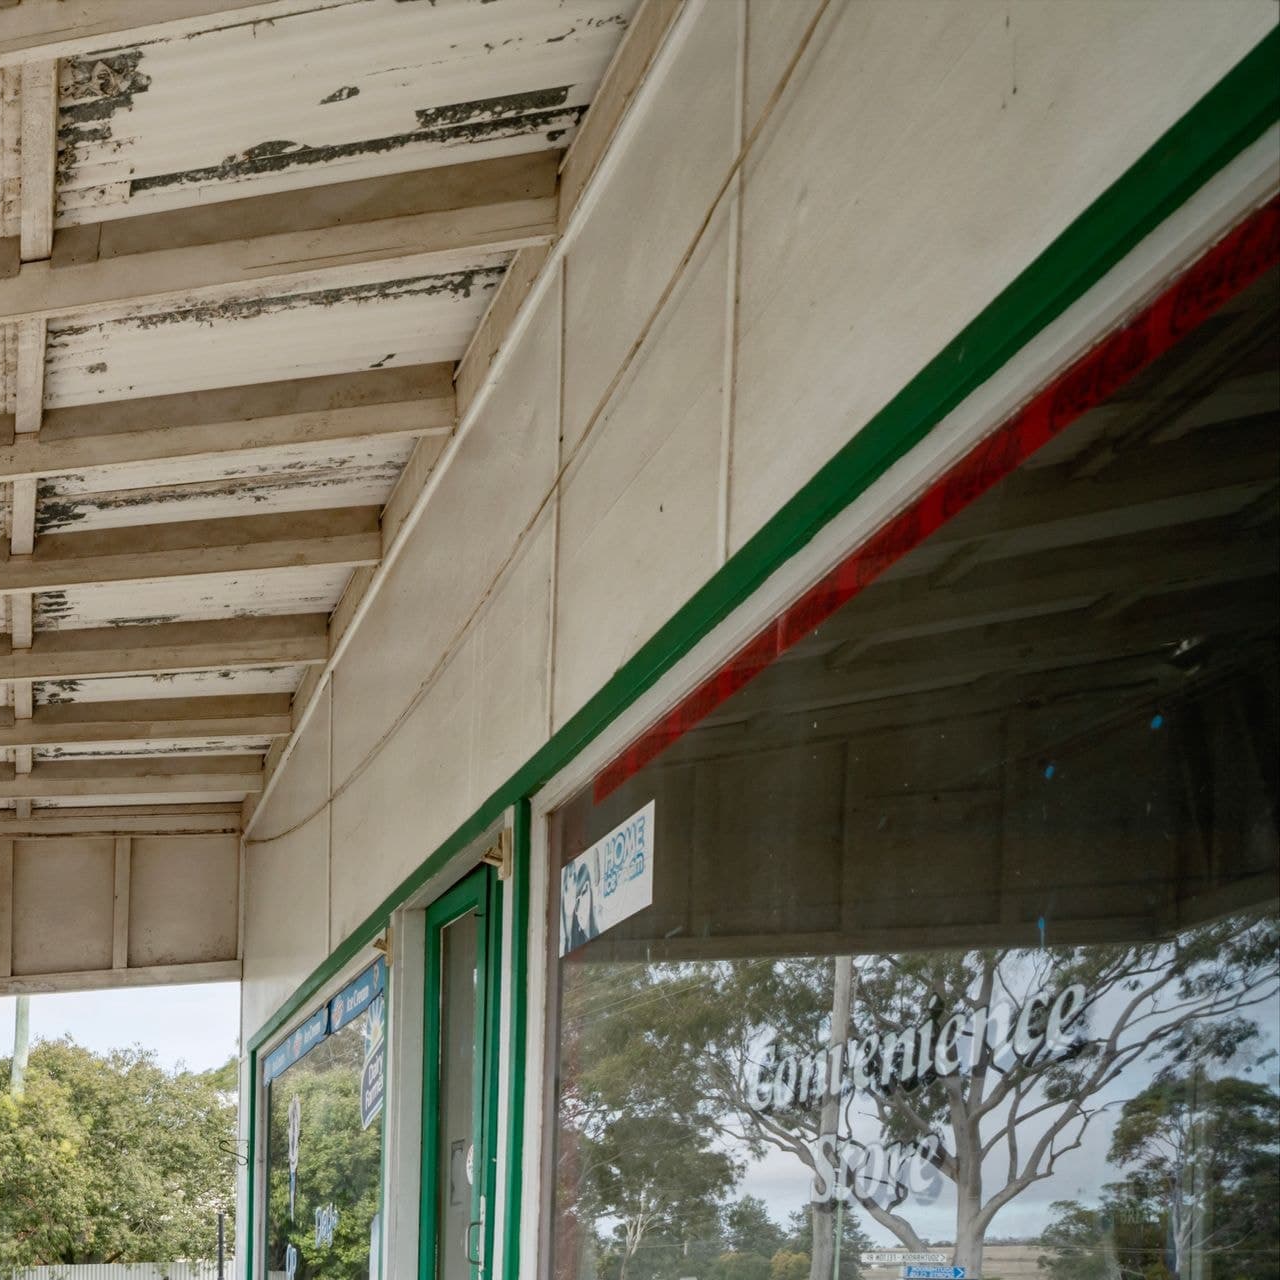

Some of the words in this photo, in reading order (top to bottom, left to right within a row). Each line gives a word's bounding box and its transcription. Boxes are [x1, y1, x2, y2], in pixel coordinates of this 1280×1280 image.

[604, 816, 645, 870] HOME
[743, 983, 1088, 1111] Convenience
[811, 1134, 942, 1202] Store
